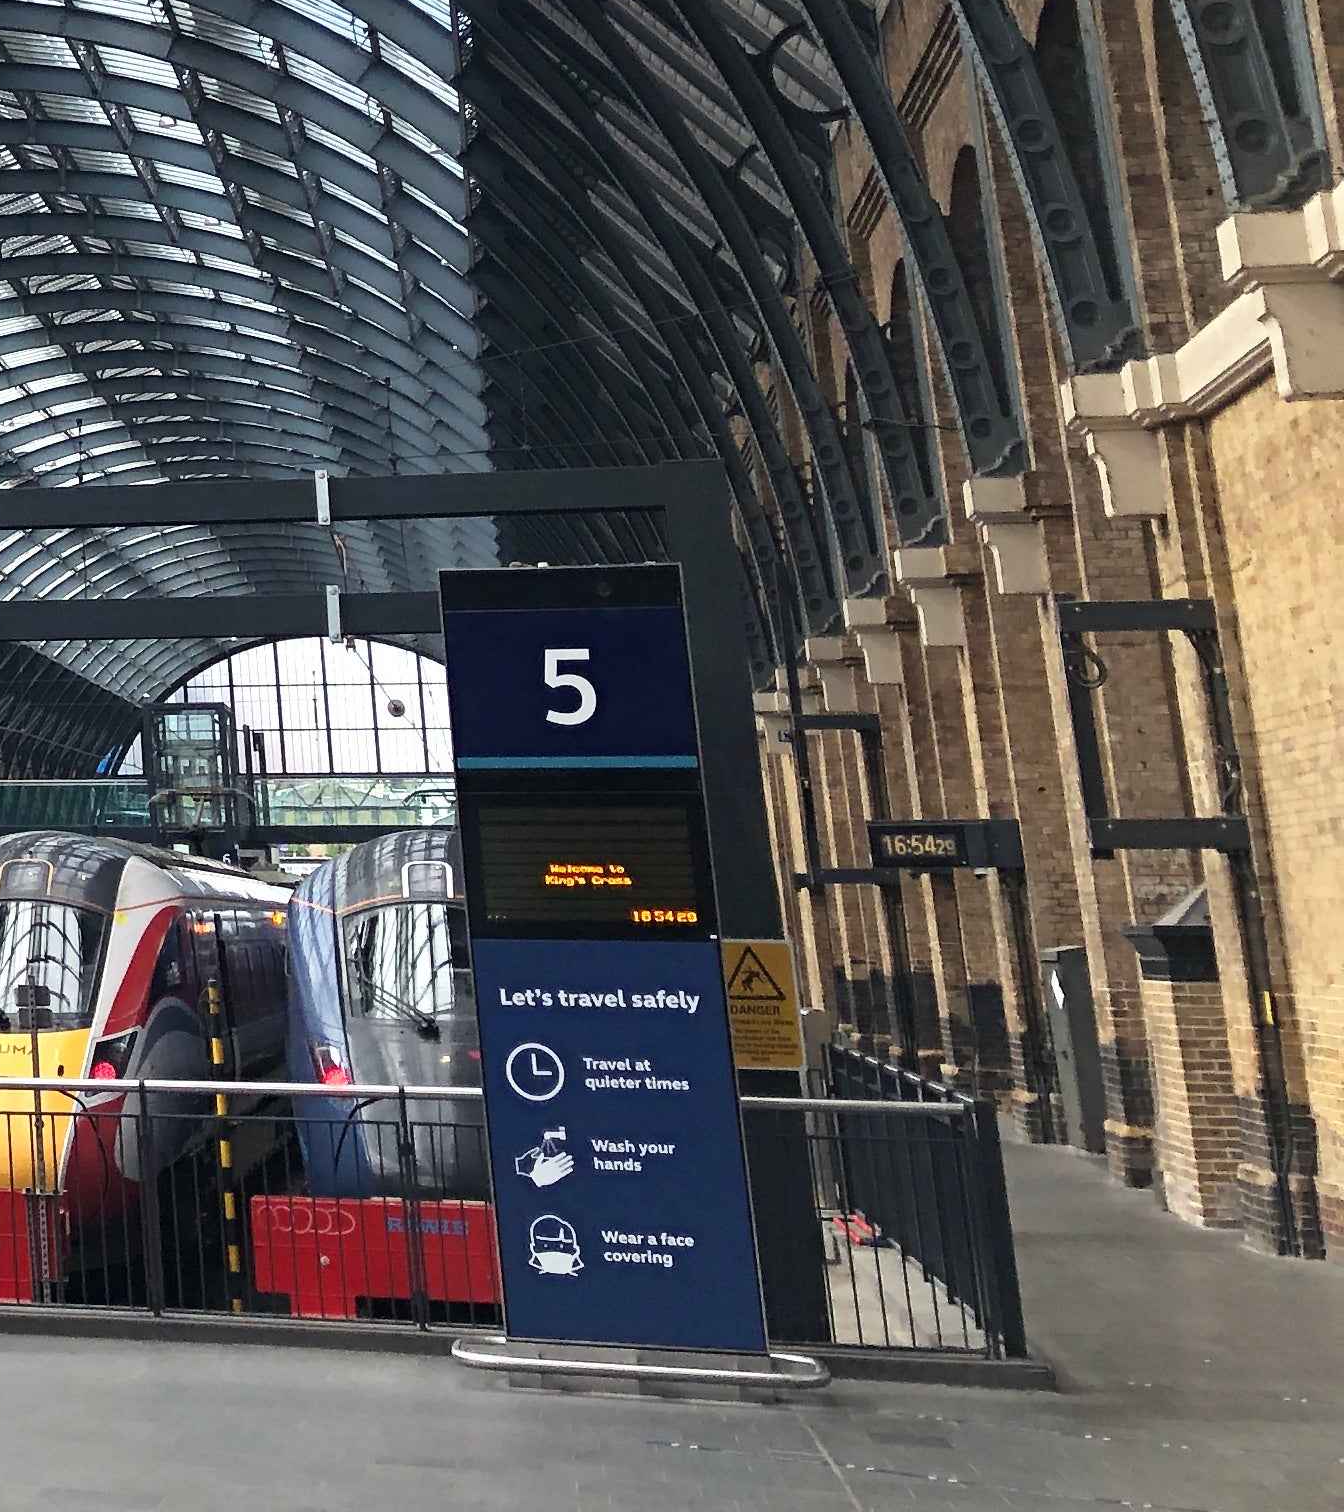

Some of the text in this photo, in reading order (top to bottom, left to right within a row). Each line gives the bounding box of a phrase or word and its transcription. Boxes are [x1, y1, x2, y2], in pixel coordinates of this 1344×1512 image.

[544, 648, 596, 725] 5
[549, 864, 625, 874] Welcome to
[545, 875, 632, 886] King's Cross
[499, 988, 700, 1014] Let's travel safely
[730, 1004, 781, 1016] DANGER
[583, 1057, 652, 1072] Travel at
[585, 1075, 690, 1091] quieter times
[591, 1139, 675, 1156] Wash your
[594, 1157, 642, 1172] hands
[601, 1230, 695, 1247] Wear a face
[604, 1250, 673, 1268] covering
